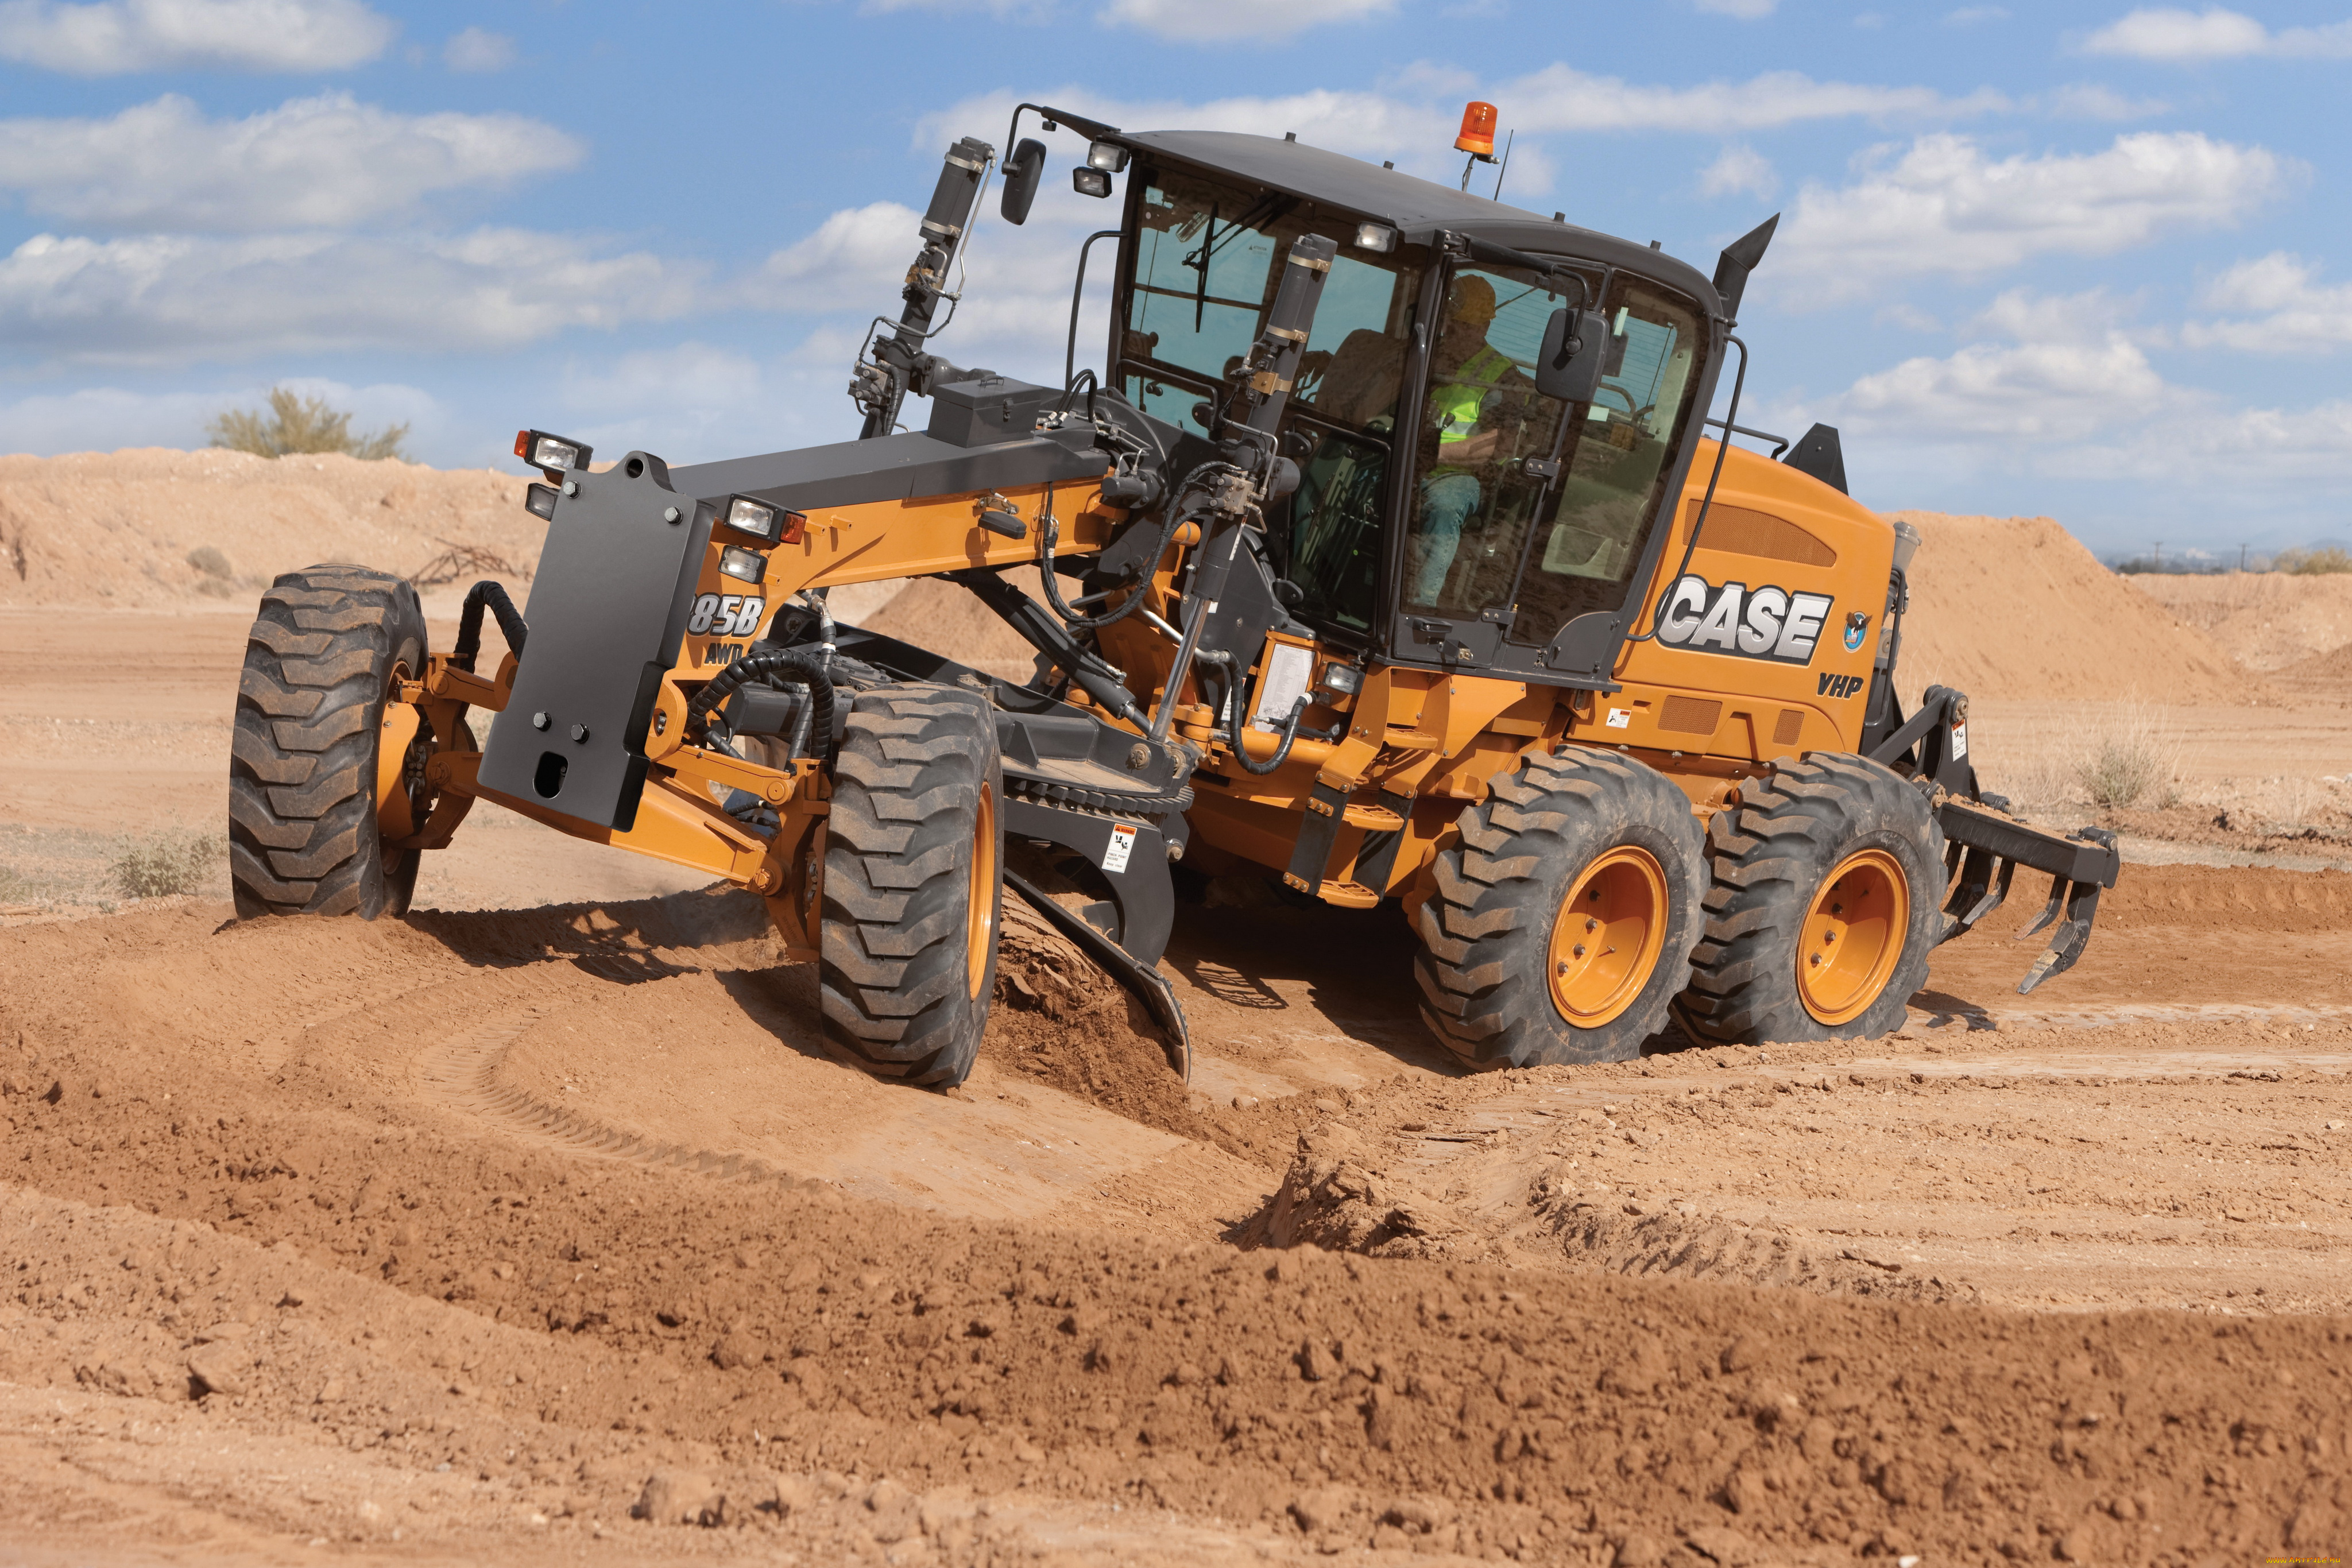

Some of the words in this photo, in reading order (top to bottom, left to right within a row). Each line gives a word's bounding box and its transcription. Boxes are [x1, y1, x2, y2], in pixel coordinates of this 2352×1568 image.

[689, 593, 765, 637] 85B
[1657, 576, 1832, 661] CASE
[704, 643, 744, 665] AWD
[1817, 672, 1864, 699] VHP
